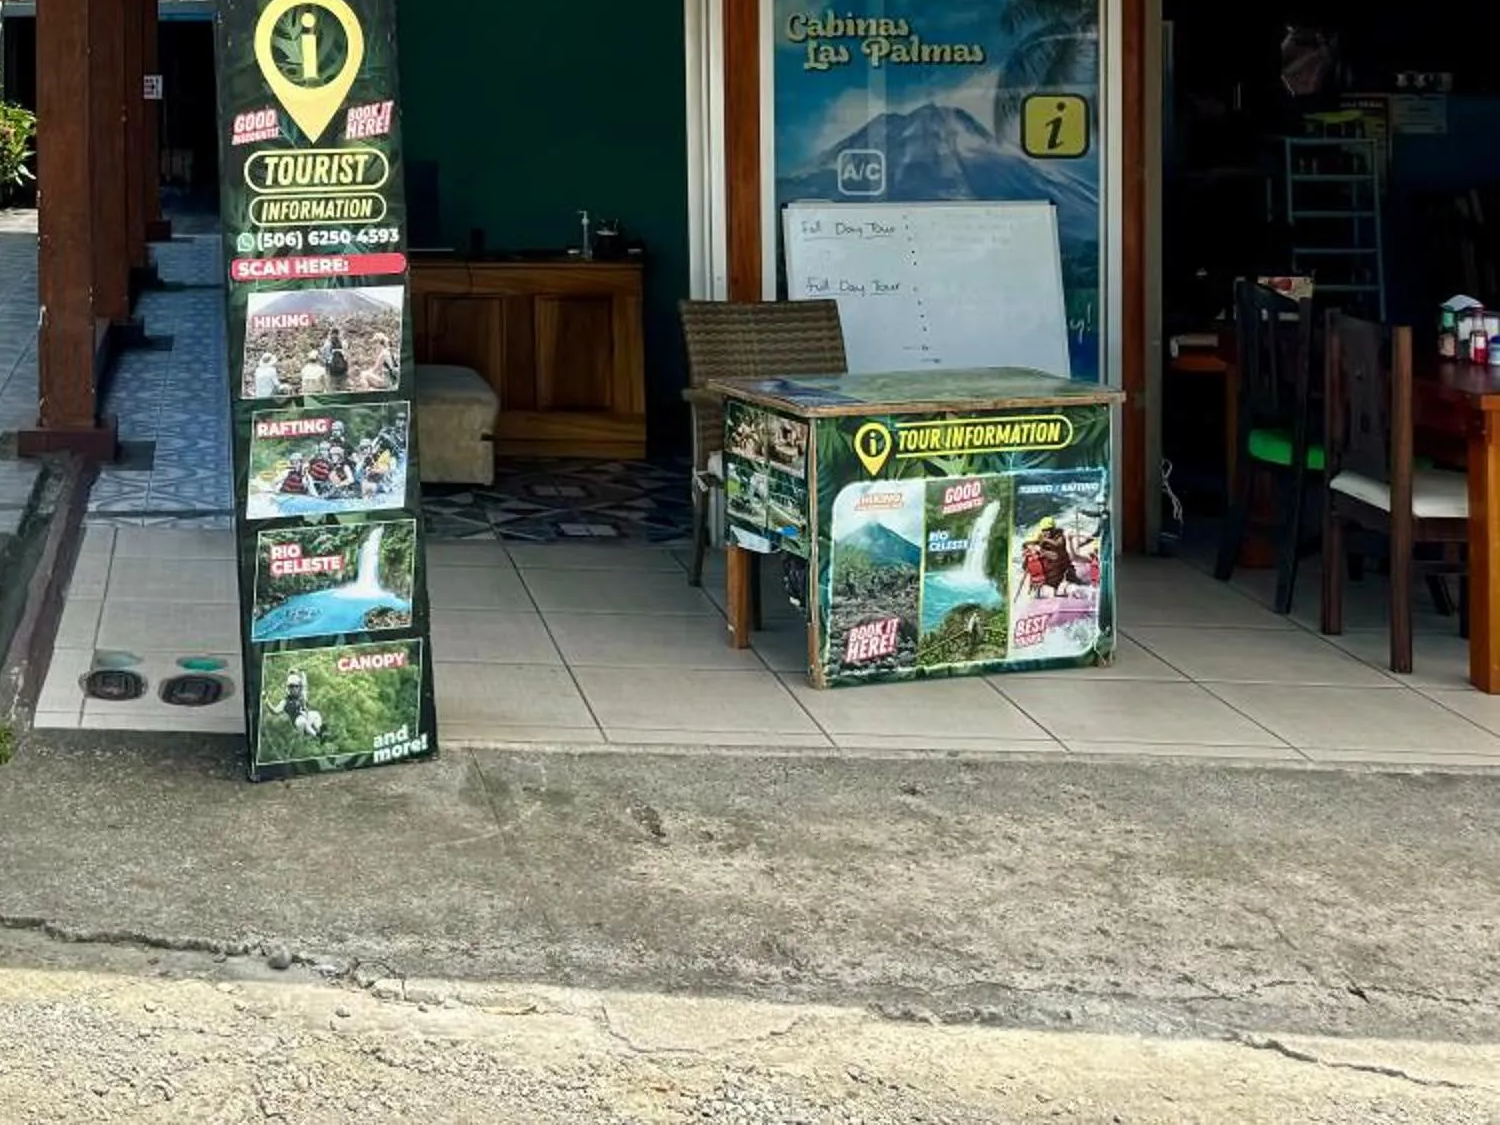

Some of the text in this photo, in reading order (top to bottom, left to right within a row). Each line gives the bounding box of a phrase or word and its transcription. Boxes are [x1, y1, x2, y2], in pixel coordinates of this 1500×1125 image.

[785, 10, 910, 42] Cabinas
[804, 36, 985, 71] Las Palmas
[234, 109, 278, 134] GOOD
[347, 100, 394, 122] BOOK IT
[345, 115, 391, 140] HERE!
[264, 154, 369, 187] TOURIST
[841, 163, 882, 181] A/C
[262, 198, 373, 223] INFORMATION
[257, 231, 303, 251] (506)
[835, 222, 863, 238] Day
[238, 261, 290, 278] SCAN
[840, 279, 866, 296] Day
[872, 280, 900, 292] Tour
[252, 315, 310, 329] HIKING
[257, 420, 328, 437] RAFTING
[898, 428, 941, 451] TOUR
[945, 422, 1061, 448] INFORMATION
[945, 481, 981, 504] GOOD
[271, 545, 301, 559] RIO
[271, 555, 342, 575] CELESTE
[849, 618, 900, 642] BOOK IT
[1016, 616, 1048, 636] BEST
[845, 633, 897, 663] HERE!
[337, 653, 406, 671] CANOPY
[373, 725, 408, 748] and
[373, 733, 429, 763] more!
